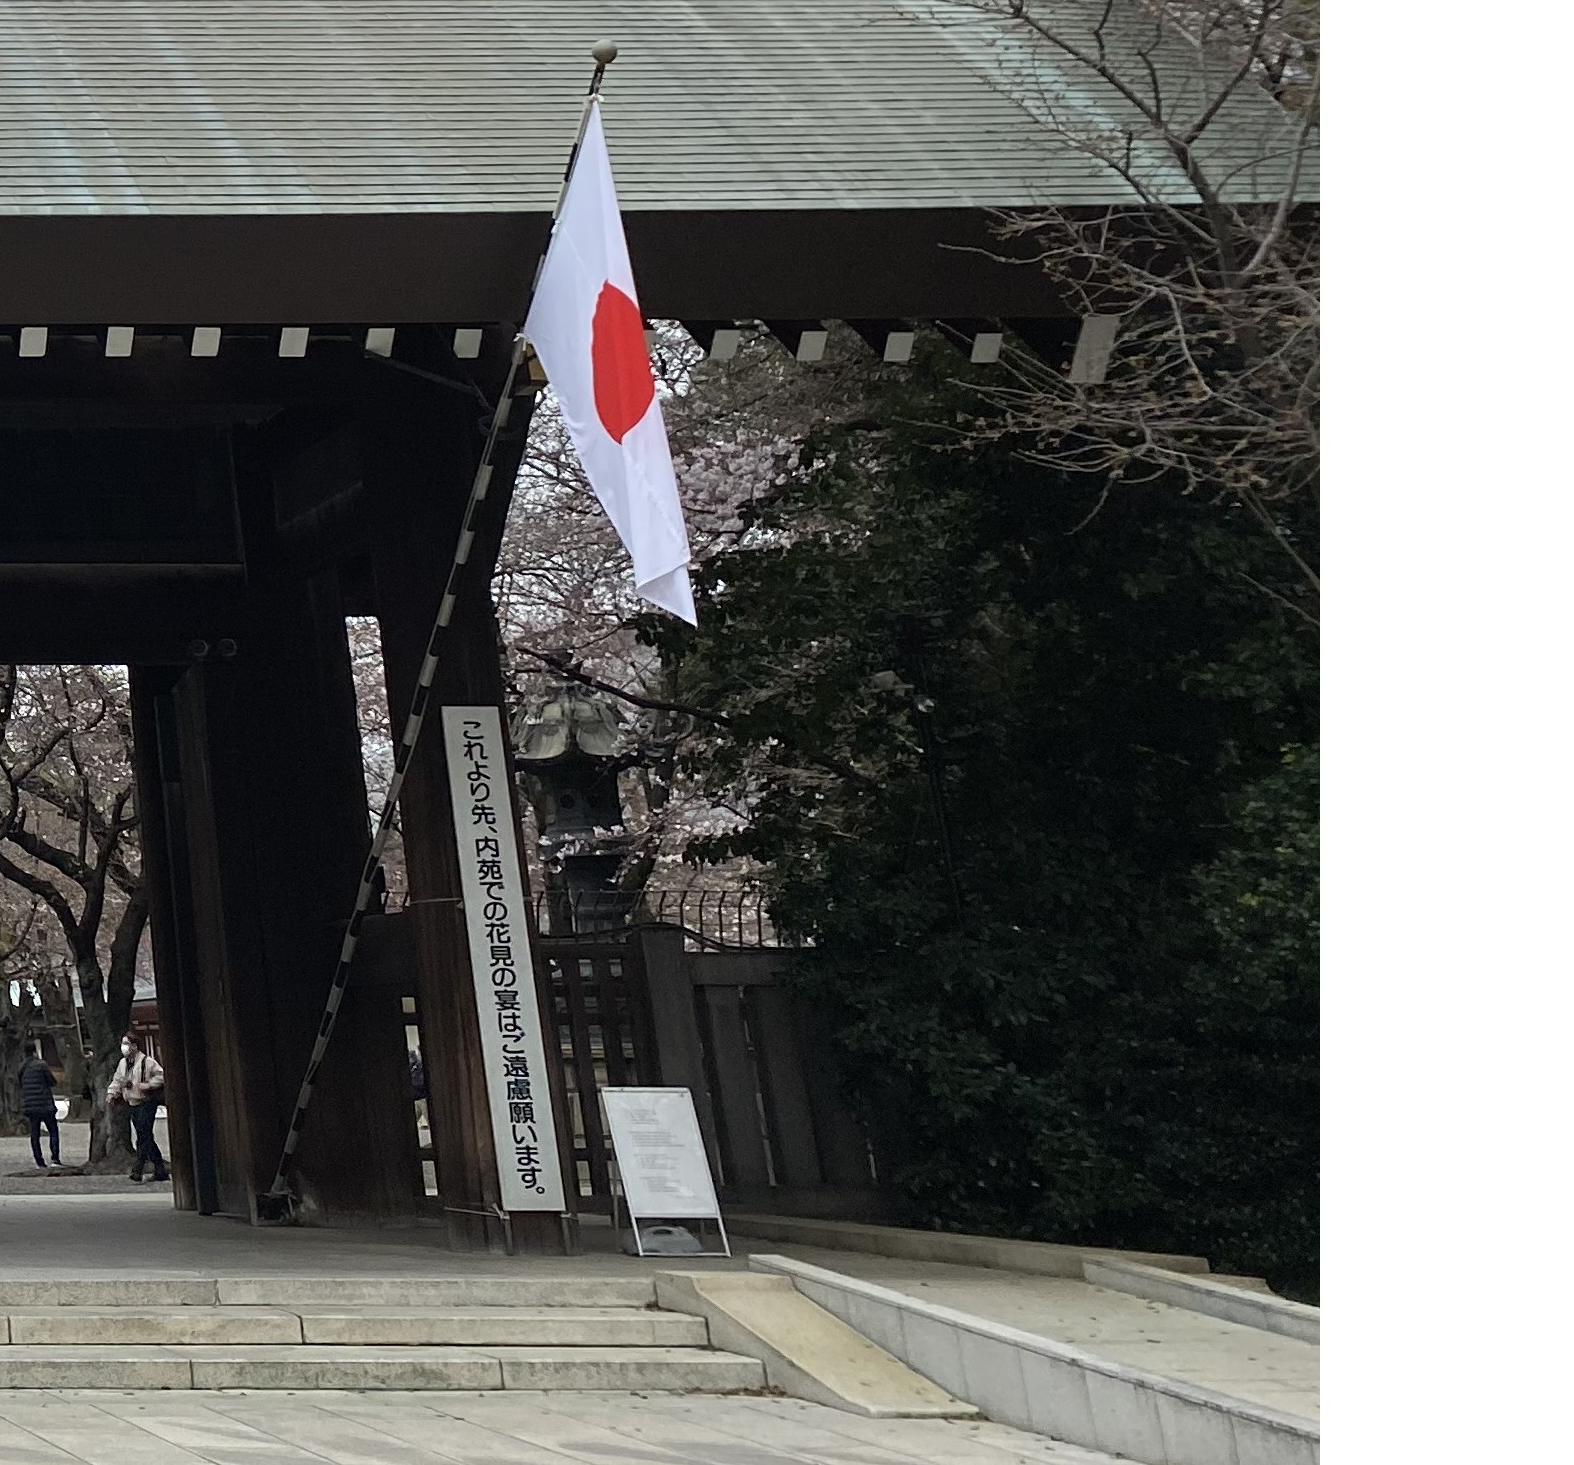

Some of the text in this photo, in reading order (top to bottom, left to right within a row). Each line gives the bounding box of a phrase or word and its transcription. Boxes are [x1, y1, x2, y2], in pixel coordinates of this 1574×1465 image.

[463, 721, 545, 1195] これより先、内苑での花見の宴はご遠慮願います。
